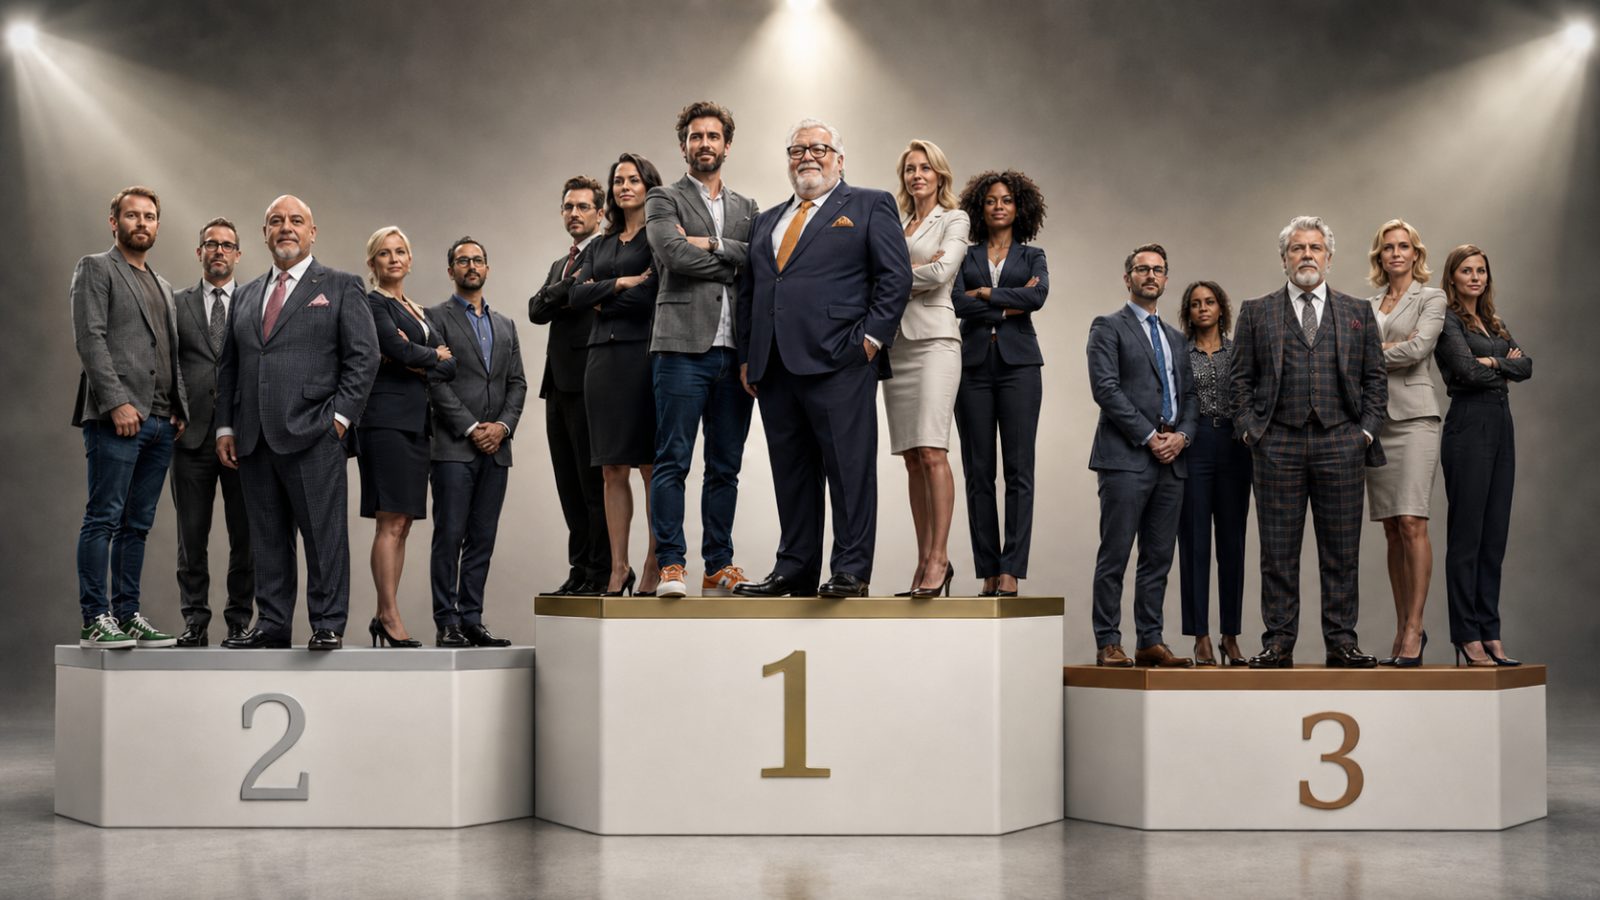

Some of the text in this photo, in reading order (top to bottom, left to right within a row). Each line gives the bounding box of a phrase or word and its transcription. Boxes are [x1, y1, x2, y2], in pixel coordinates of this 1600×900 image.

[240, 693, 309, 801] 2
[761, 650, 831, 778] 1
[1299, 711, 1364, 810] 3
